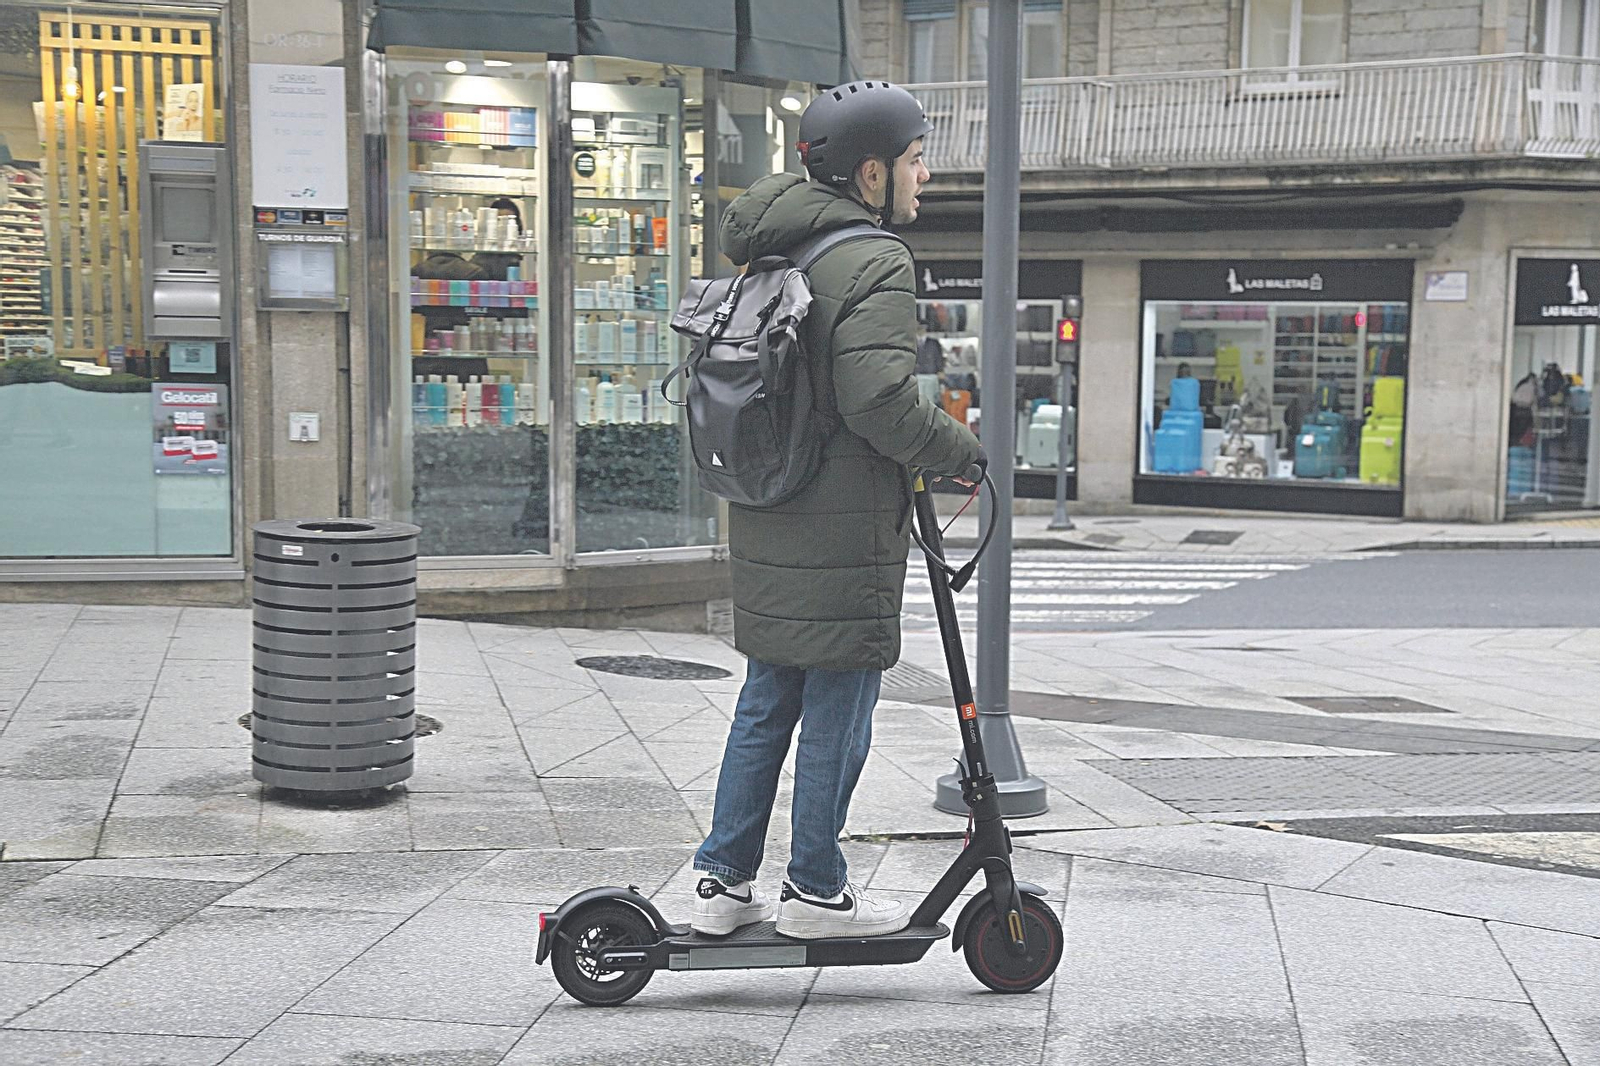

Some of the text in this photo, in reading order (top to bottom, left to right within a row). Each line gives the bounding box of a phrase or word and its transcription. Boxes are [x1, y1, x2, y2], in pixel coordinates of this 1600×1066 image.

[258, 233, 292, 242] TURNOS
[305, 235, 344, 243] GUARDIA
[938, 278, 956, 287] LAS
[1244, 279, 1309, 289] LAS MALETAS
[1541, 305, 1599, 317] LAS MALETAS
[161, 391, 218, 404] Gelocatil
